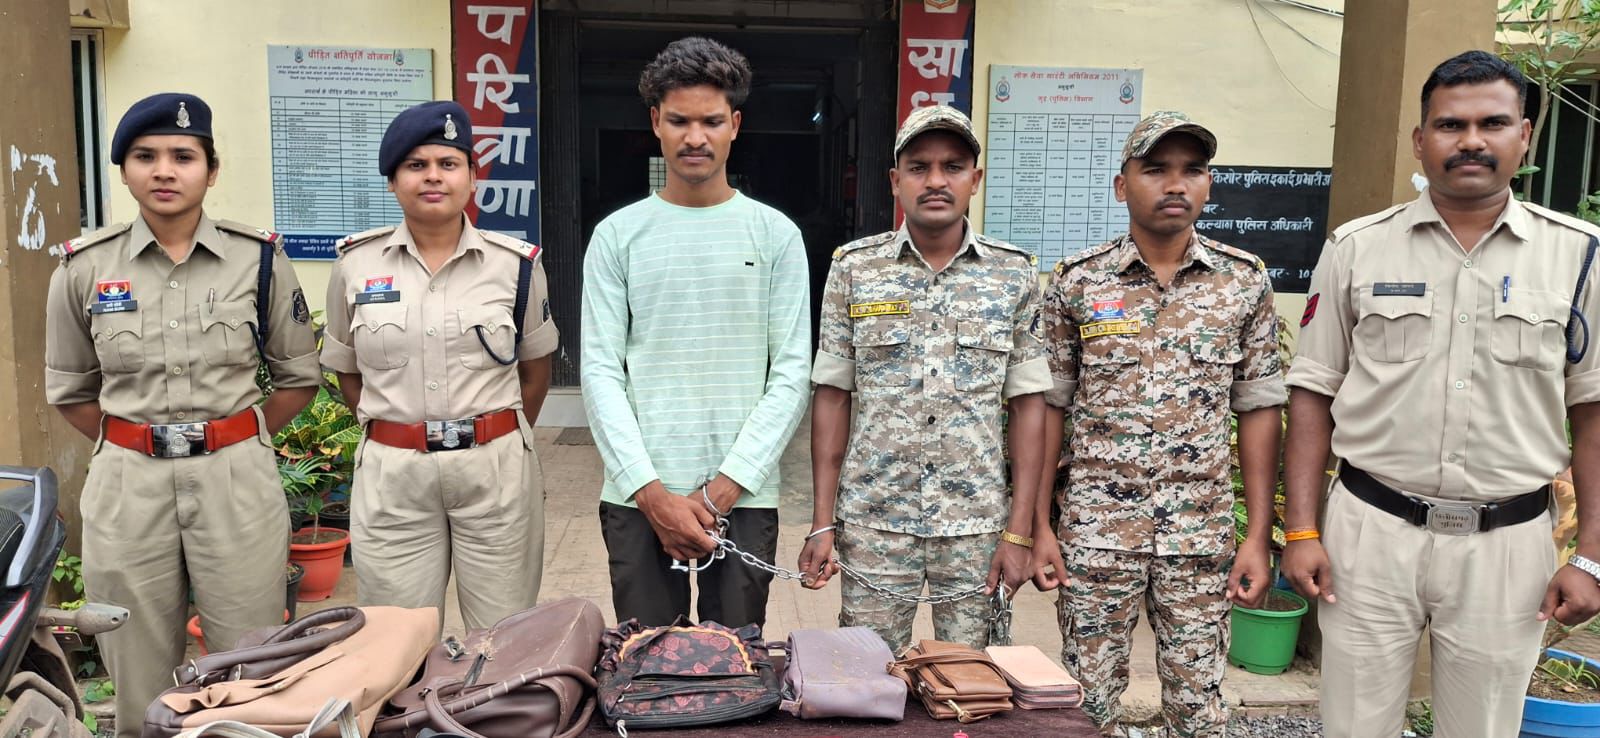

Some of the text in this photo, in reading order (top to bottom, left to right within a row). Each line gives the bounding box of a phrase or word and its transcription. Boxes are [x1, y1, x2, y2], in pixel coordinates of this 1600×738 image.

[1102, 73, 1119, 81] 2011
[1244, 170, 1271, 188] पुलिस
[1236, 217, 1268, 234] पुलिस
[1270, 217, 1314, 231] अधिकारी
[1299, 269, 1312, 279] 10
